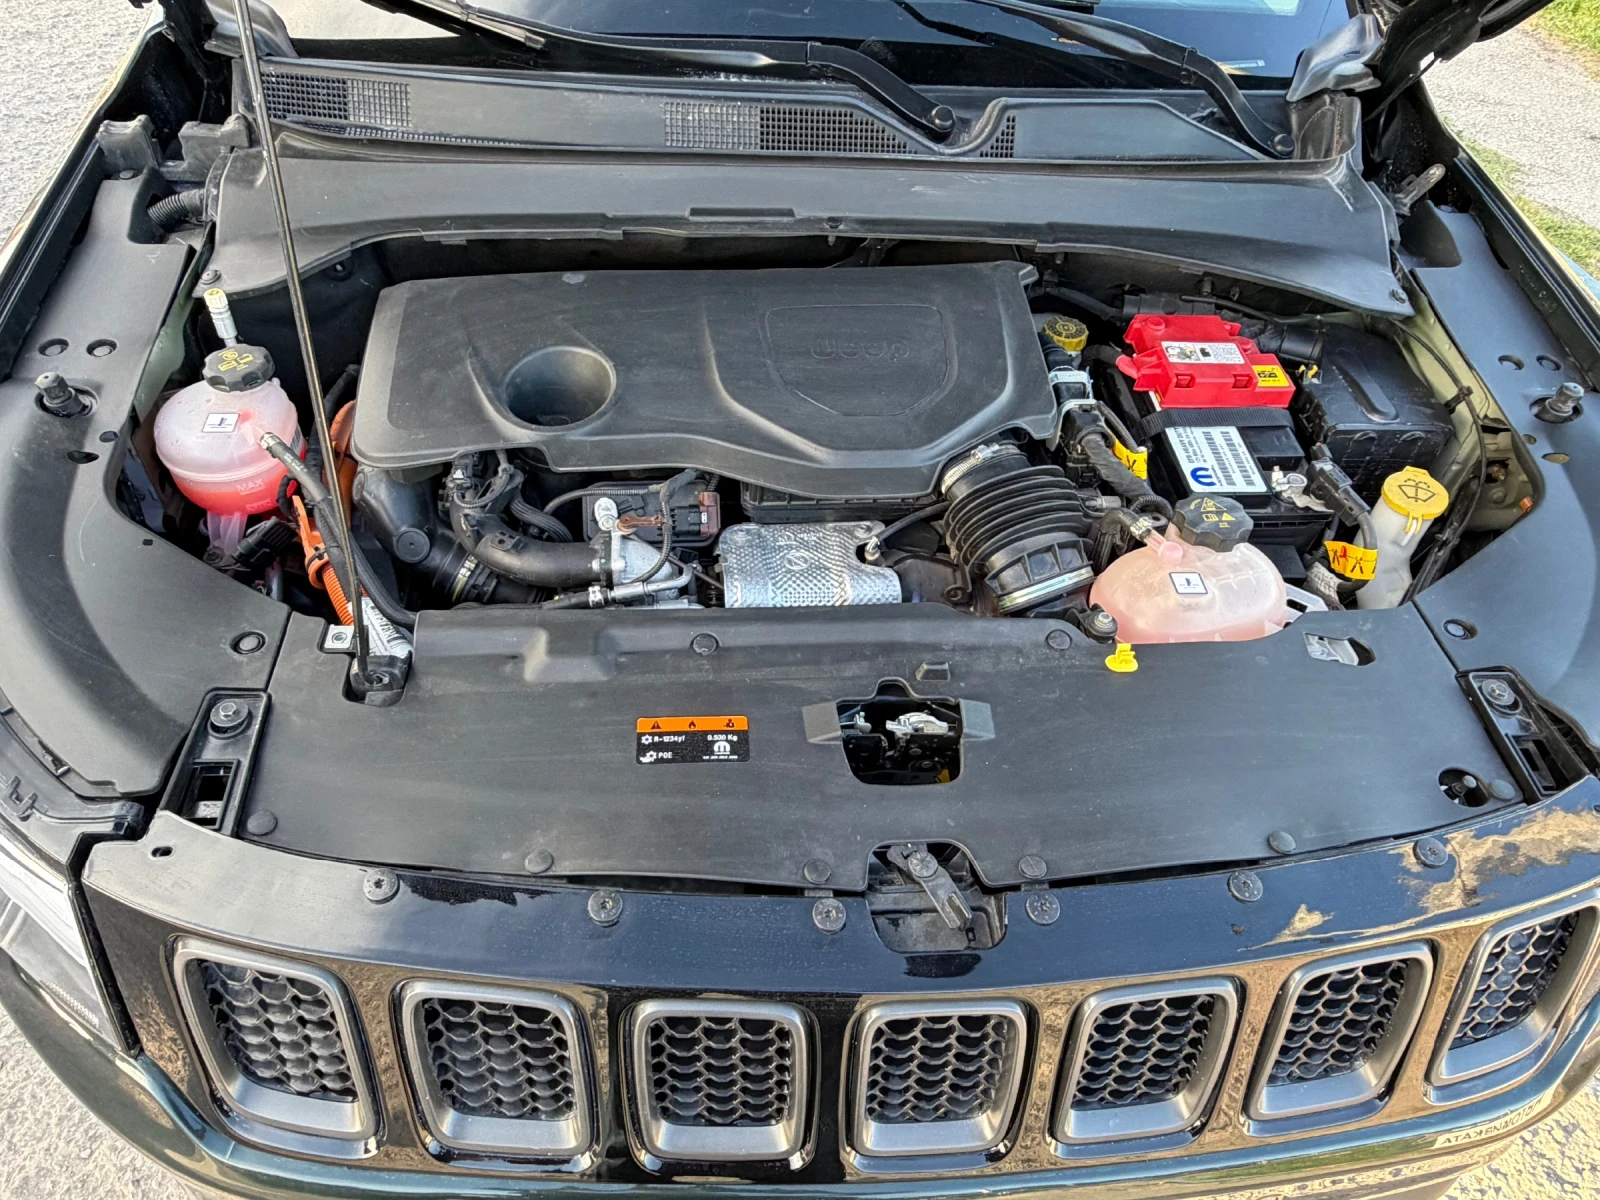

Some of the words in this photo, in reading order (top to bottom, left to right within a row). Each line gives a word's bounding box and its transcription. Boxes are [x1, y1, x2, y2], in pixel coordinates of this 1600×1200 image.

[236, 478, 264, 492] MAX
[653, 734, 686, 743] R-1234yf
[727, 734, 738, 742] Kg
[658, 751, 673, 759] POE
